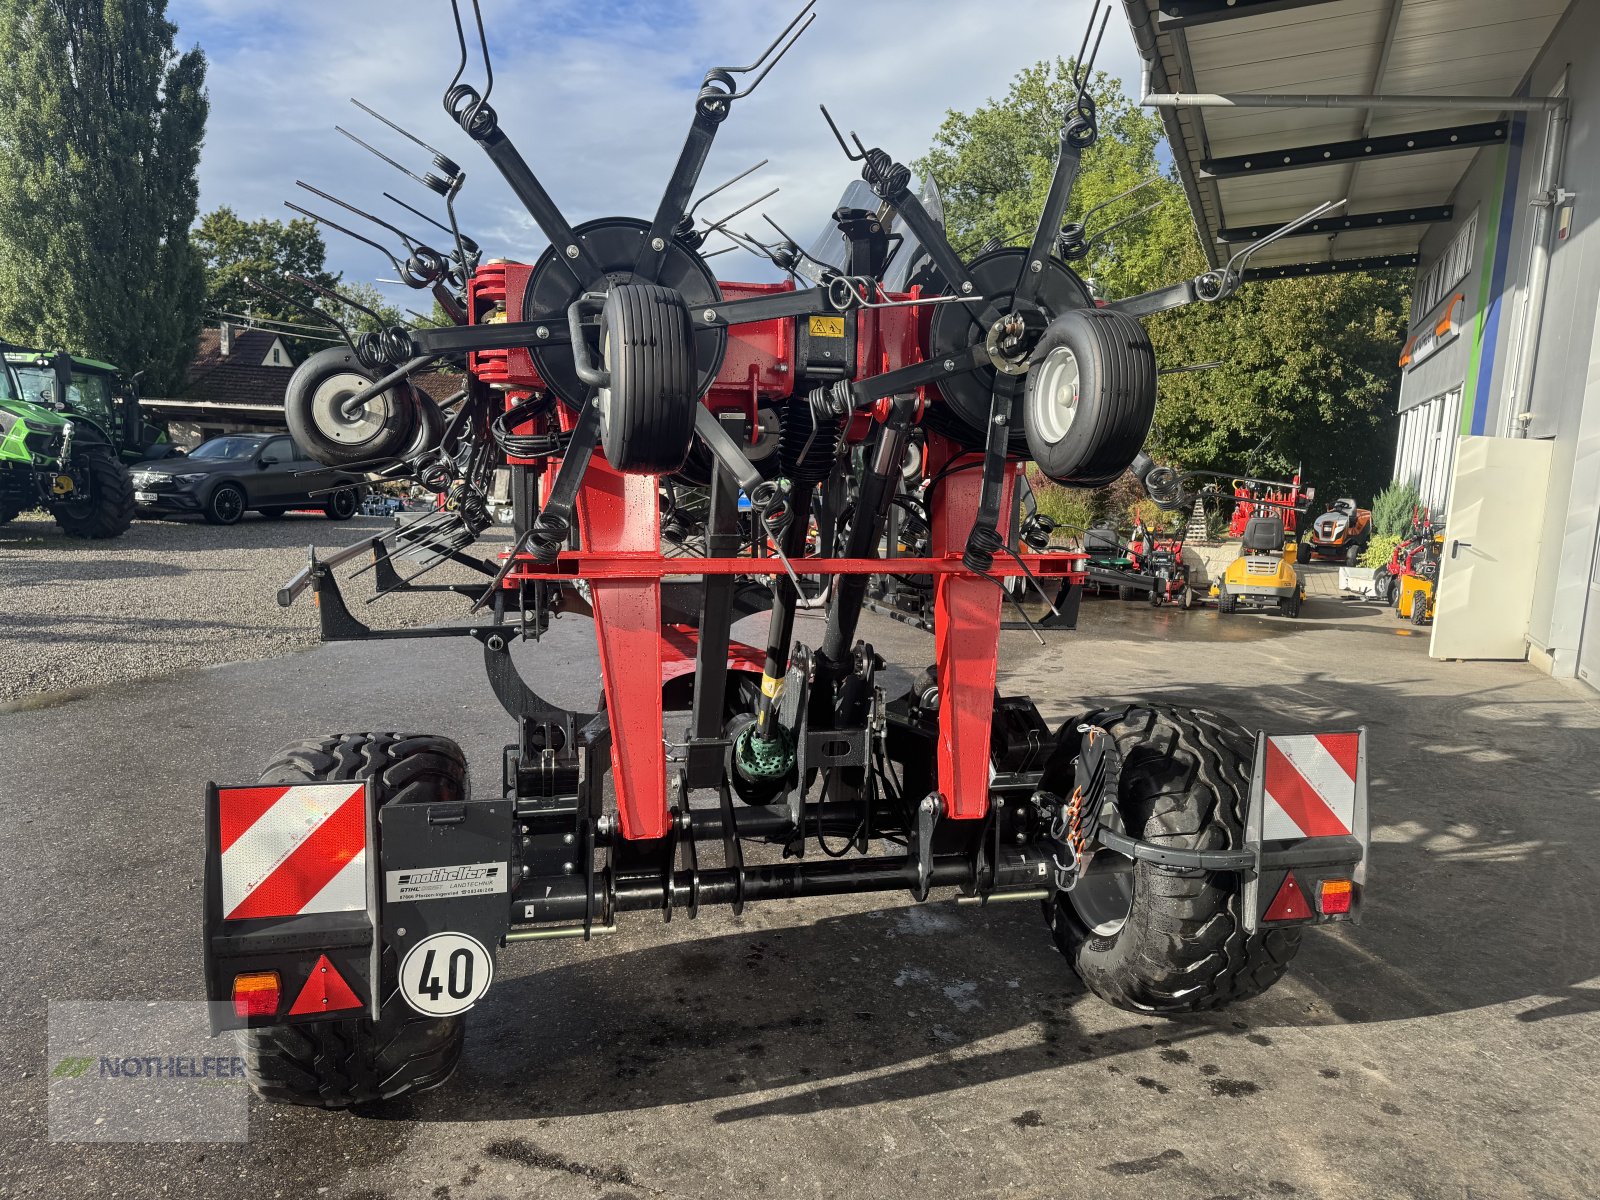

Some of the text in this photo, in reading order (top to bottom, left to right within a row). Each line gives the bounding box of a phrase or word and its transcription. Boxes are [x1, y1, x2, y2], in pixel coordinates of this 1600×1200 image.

[410, 866, 487, 884] nothelfer
[449, 880, 494, 889] LANDTECHNIK
[418, 947, 474, 1001] 40
